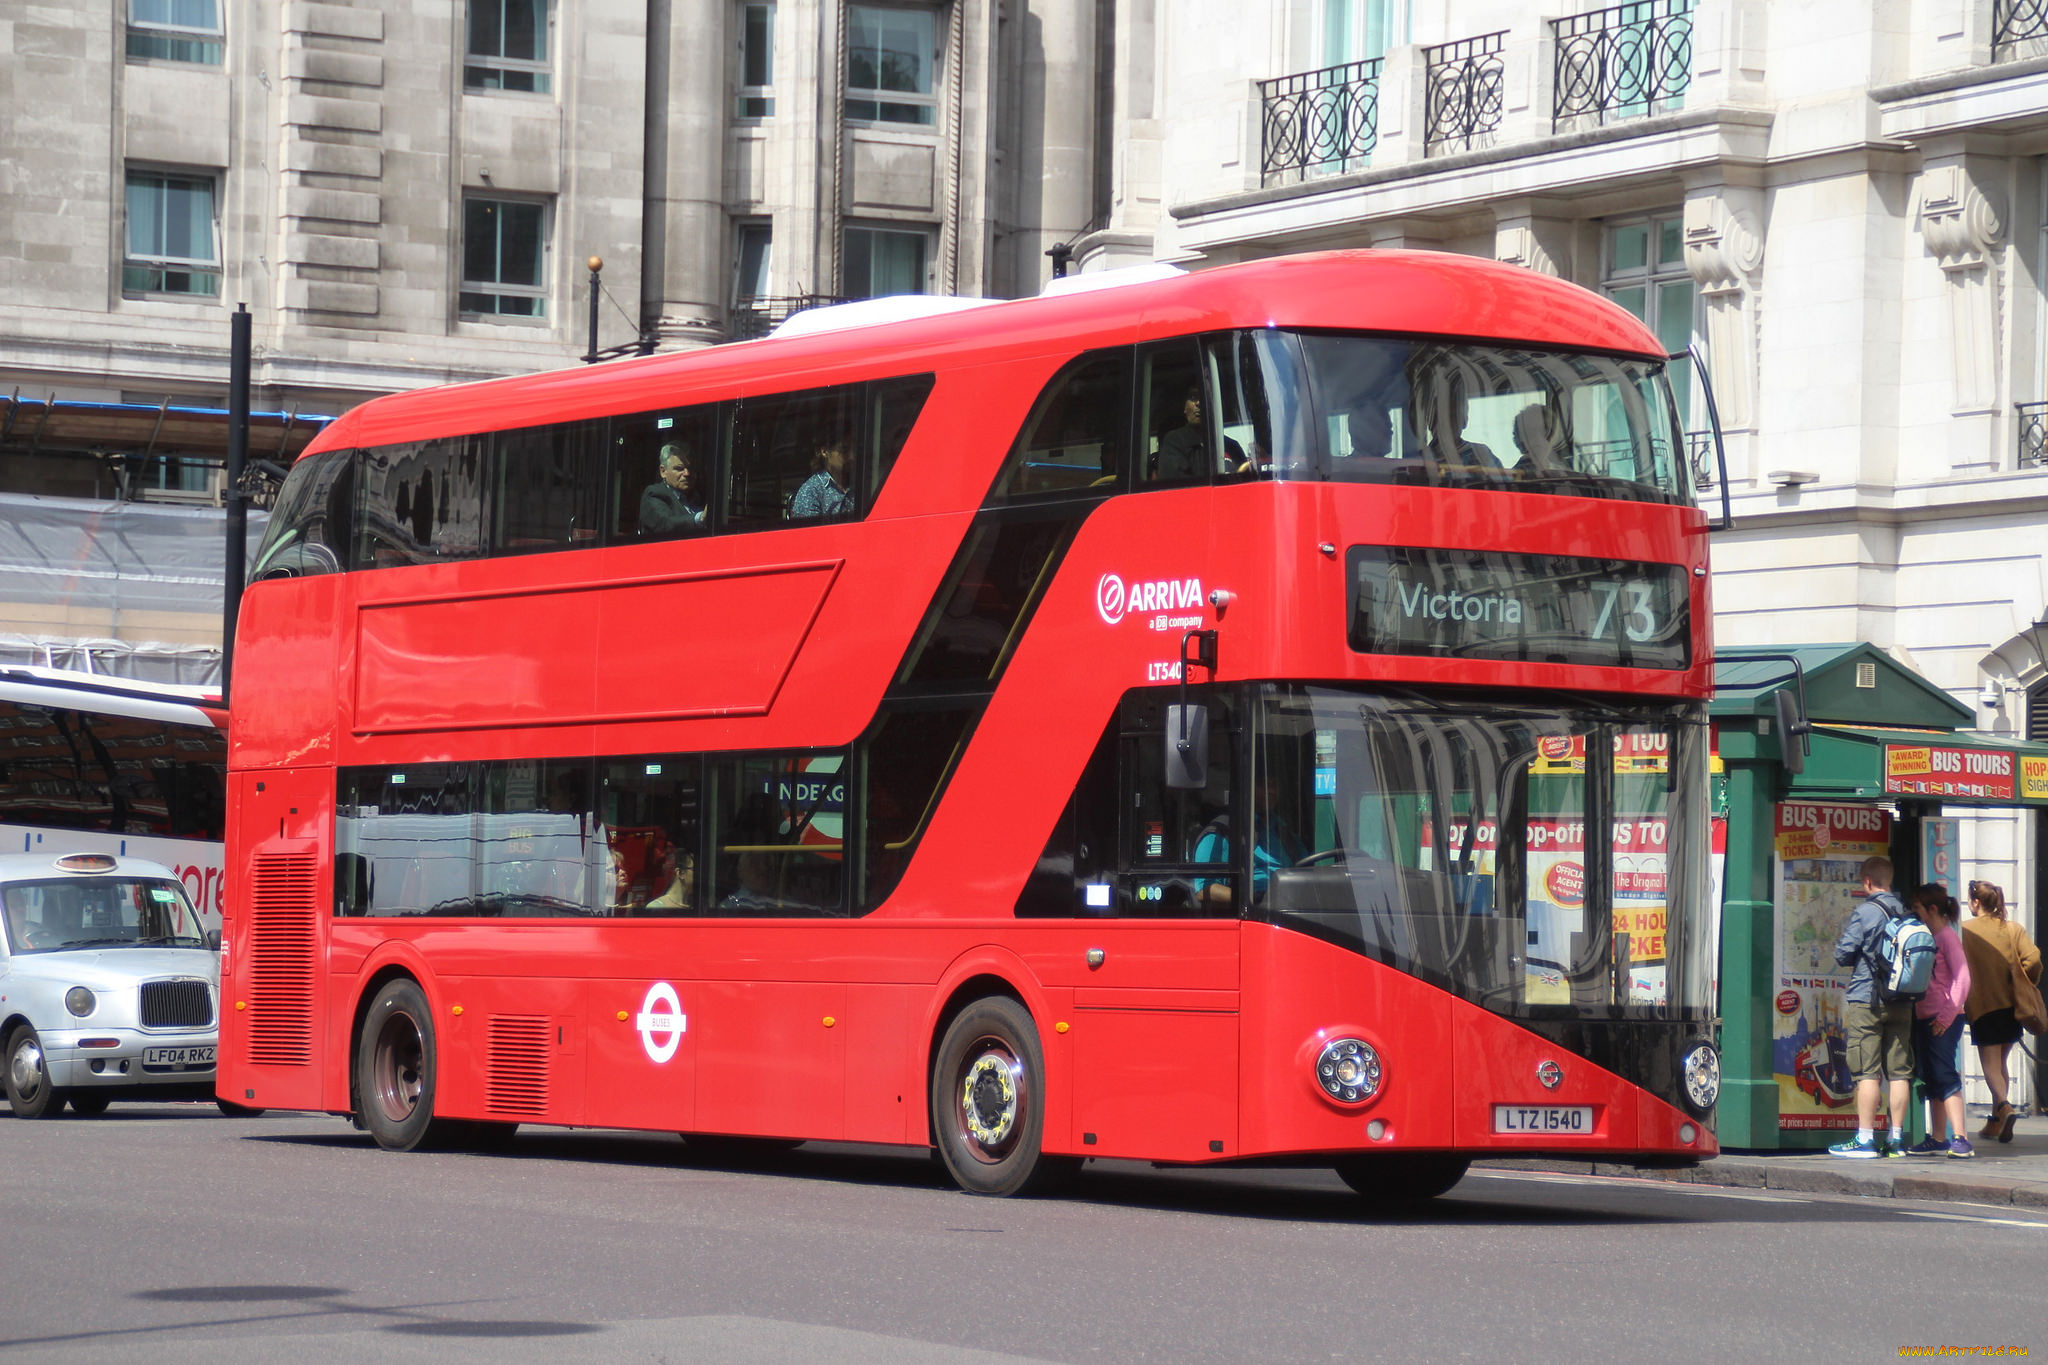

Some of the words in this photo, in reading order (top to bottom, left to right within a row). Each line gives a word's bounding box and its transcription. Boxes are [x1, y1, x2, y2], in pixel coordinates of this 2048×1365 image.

[1127, 579, 1204, 612] ARRIVA
[1399, 582, 1522, 623] Victoria
[1591, 581, 1656, 642] 73
[1149, 619, 1155, 629] a
[1168, 615, 1203, 629] company
[1148, 661, 1182, 681] LT540
[1895, 750, 1924, 761] AWARD
[1932, 751, 1962, 773] BUS
[1964, 753, 2011, 776] TOURS
[1892, 761, 1928, 771] WINNING
[2025, 761, 2048, 777] HOP
[1782, 805, 1819, 829] BUS
[1822, 807, 1882, 831] TOURS
[1784, 844, 1821, 857] TICKETS
[1555, 864, 1584, 879] OFFICIA
[1556, 876, 1584, 889] AGENT
[1616, 872, 1630, 887] The
[1632, 872, 1663, 892] Original
[652, 1017, 671, 1028] BUSES
[148, 1049, 186, 1063] LF04
[188, 1047, 214, 1062] RKZ
[1506, 1110, 1540, 1130] LTZ
[1543, 1110, 1582, 1130] 1540
